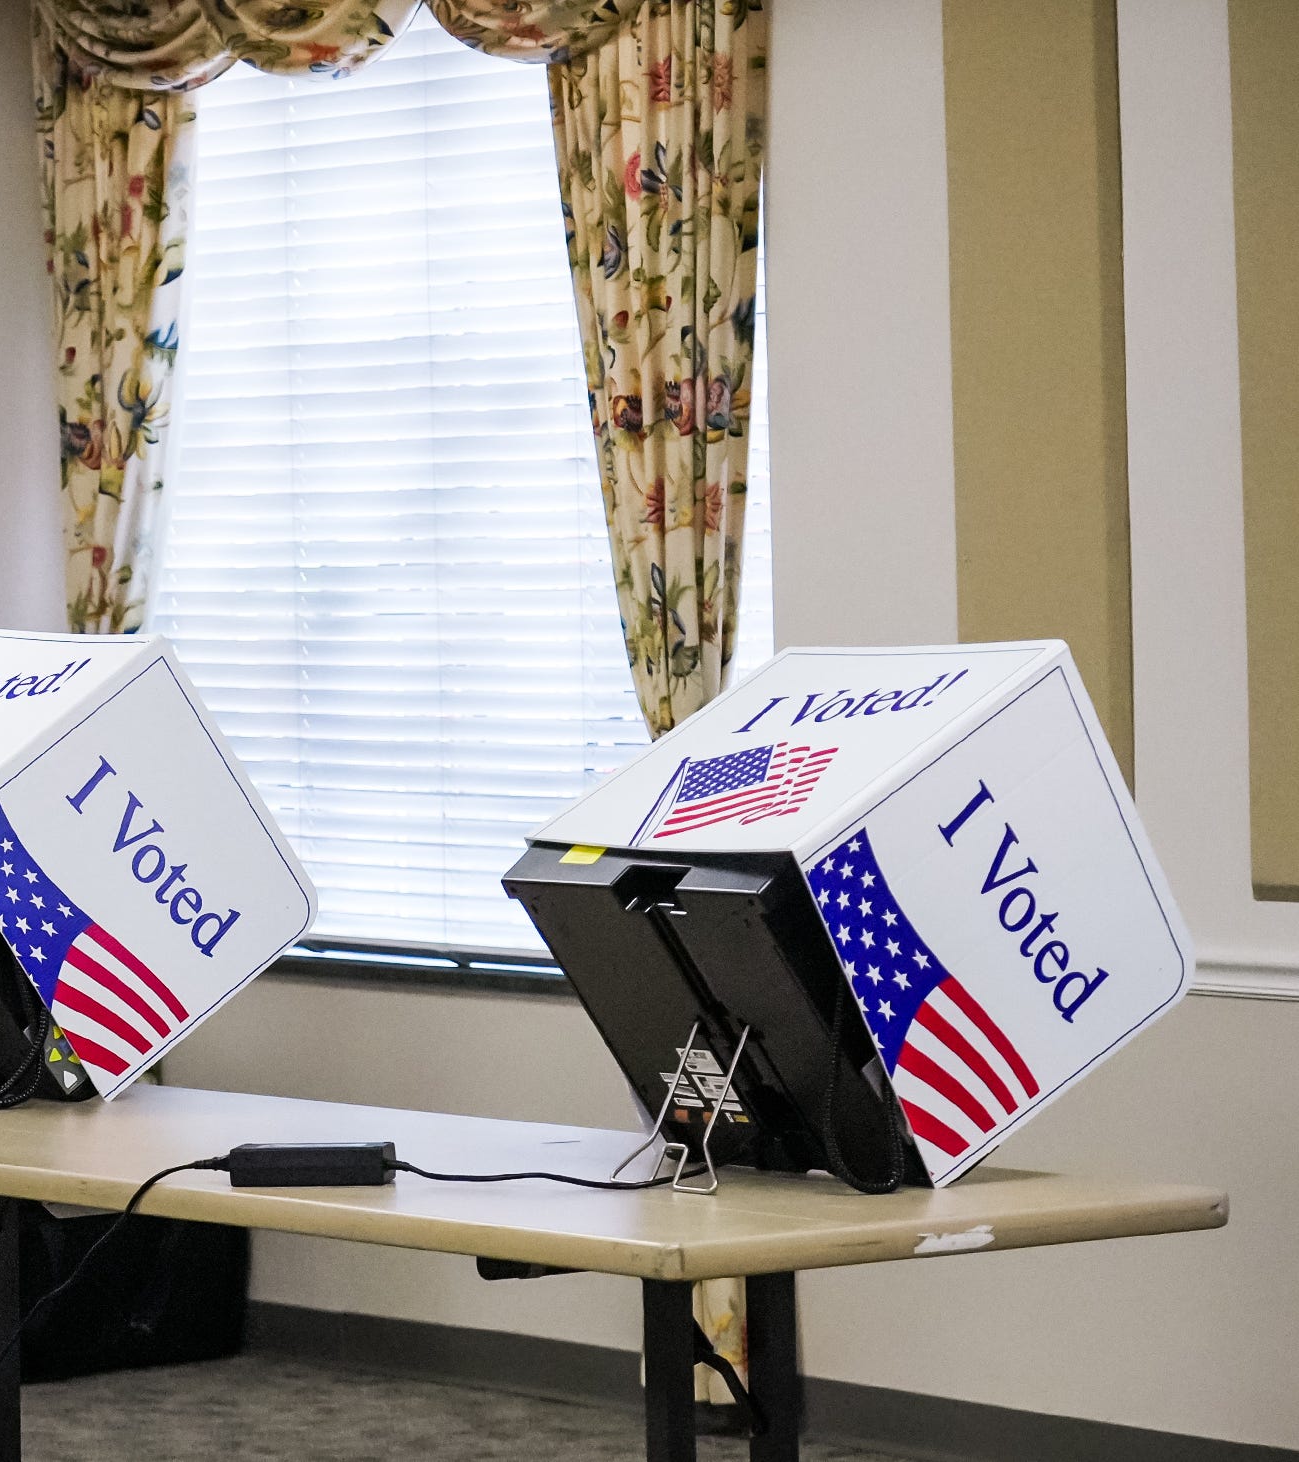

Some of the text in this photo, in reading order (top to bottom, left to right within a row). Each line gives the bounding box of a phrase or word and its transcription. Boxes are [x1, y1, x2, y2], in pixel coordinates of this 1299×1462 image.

[732, 669, 969, 734] I Voted!
[64, 754, 241, 959] I Voted
[937, 779, 1110, 1024] I Voted
